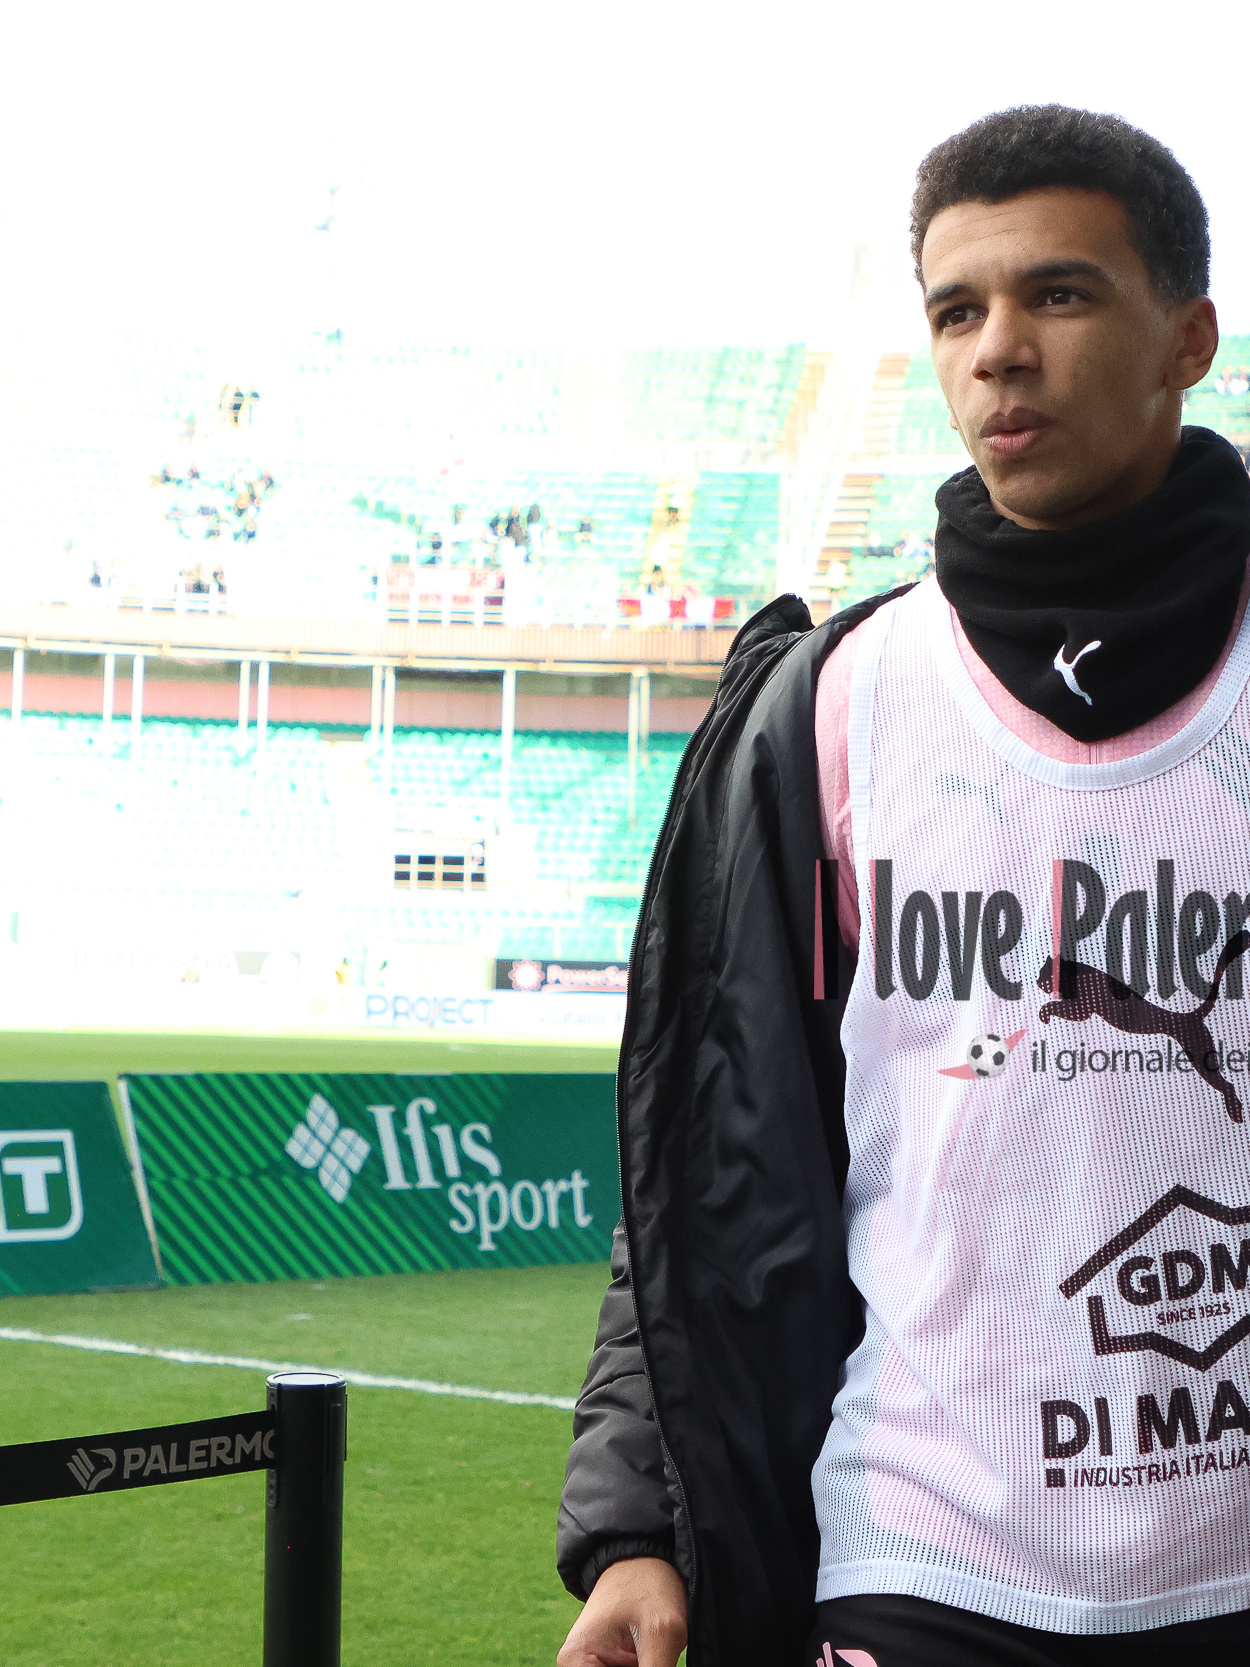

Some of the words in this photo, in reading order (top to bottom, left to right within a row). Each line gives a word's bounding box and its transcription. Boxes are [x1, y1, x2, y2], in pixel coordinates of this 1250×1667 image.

[365, 994, 495, 1028] PROJECT
[367, 1097, 500, 1190] Ifis
[448, 1170, 594, 1252] sport
[1157, 1307, 1196, 1326] SINCE
[1199, 1302, 1231, 1319] 1925
[1041, 1397, 1113, 1460] DI
[1073, 1461, 1182, 1488] INDUSTRIA
